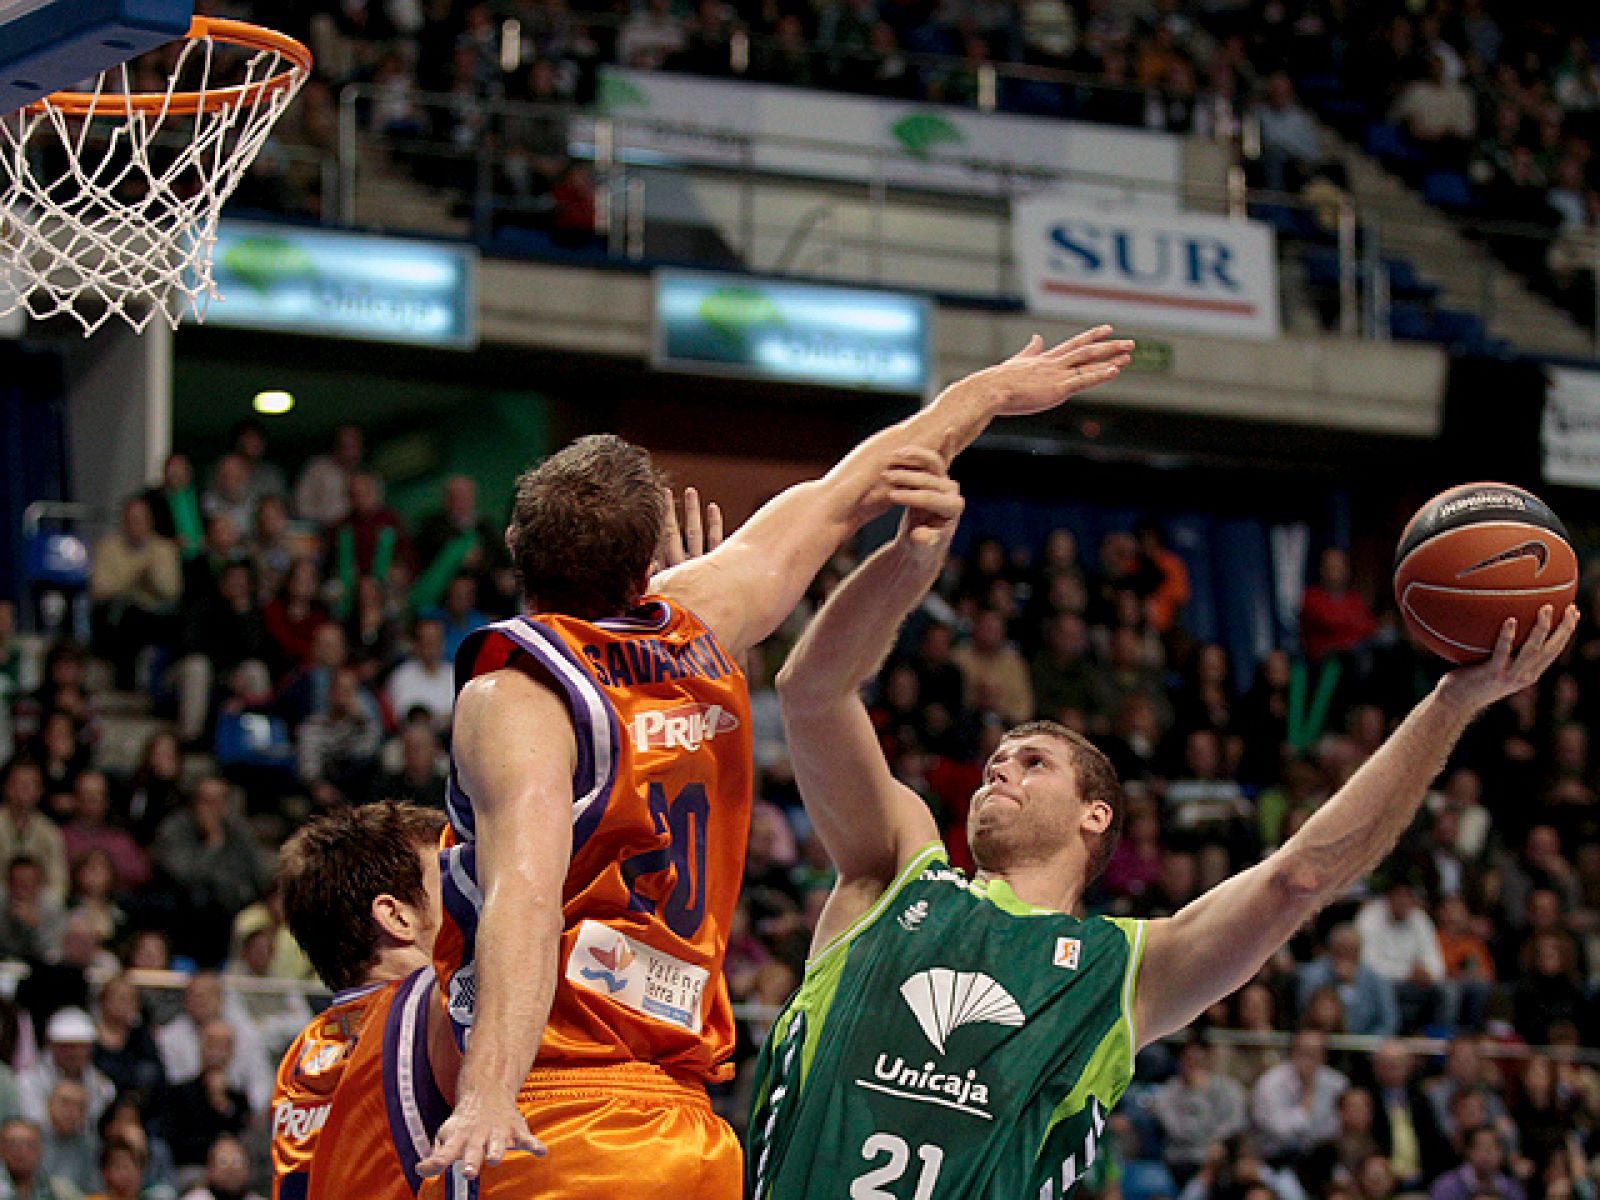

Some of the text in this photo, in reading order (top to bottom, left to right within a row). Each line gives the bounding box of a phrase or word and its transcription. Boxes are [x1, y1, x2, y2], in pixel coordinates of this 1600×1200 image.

[1047, 221, 1240, 290] SUR
[874, 1052, 989, 1104] Unicaja
[850, 1132, 944, 1200] 21
